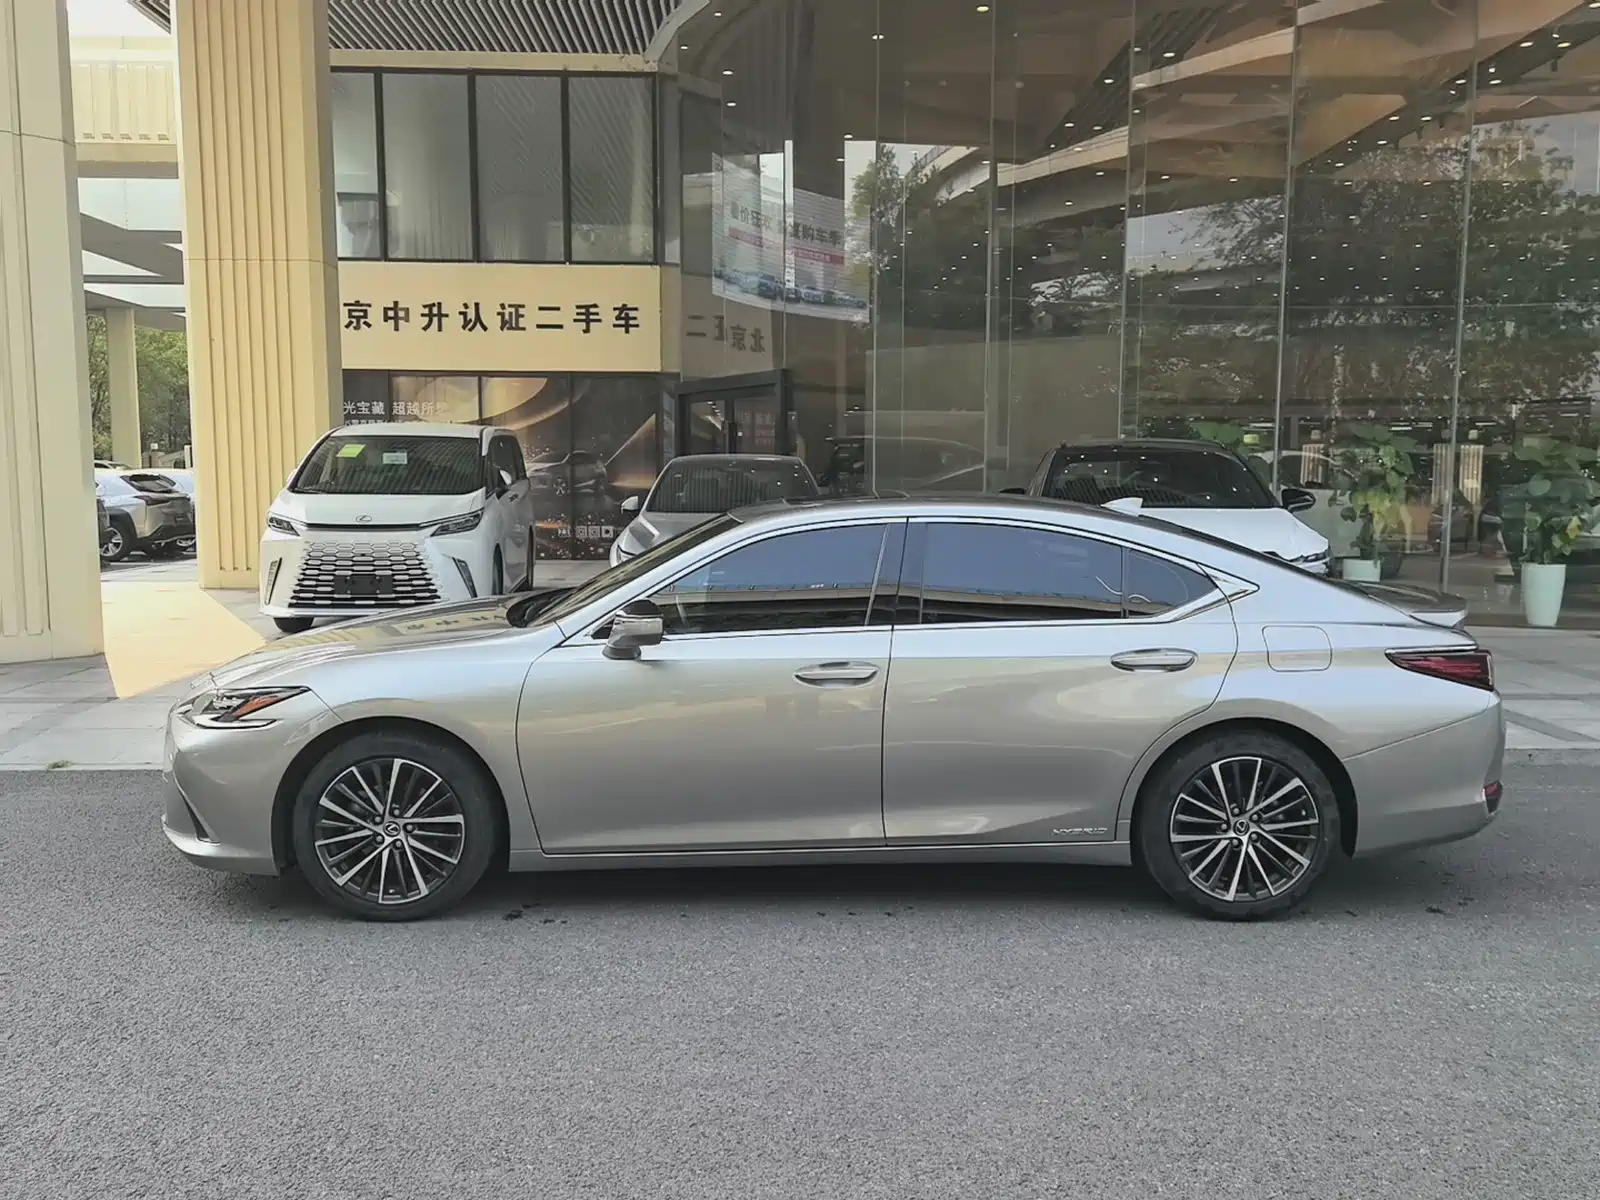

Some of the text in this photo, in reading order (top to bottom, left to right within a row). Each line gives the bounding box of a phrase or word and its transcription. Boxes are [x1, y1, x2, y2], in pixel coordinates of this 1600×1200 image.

[343, 300, 640, 333] 京中升认证二手车
